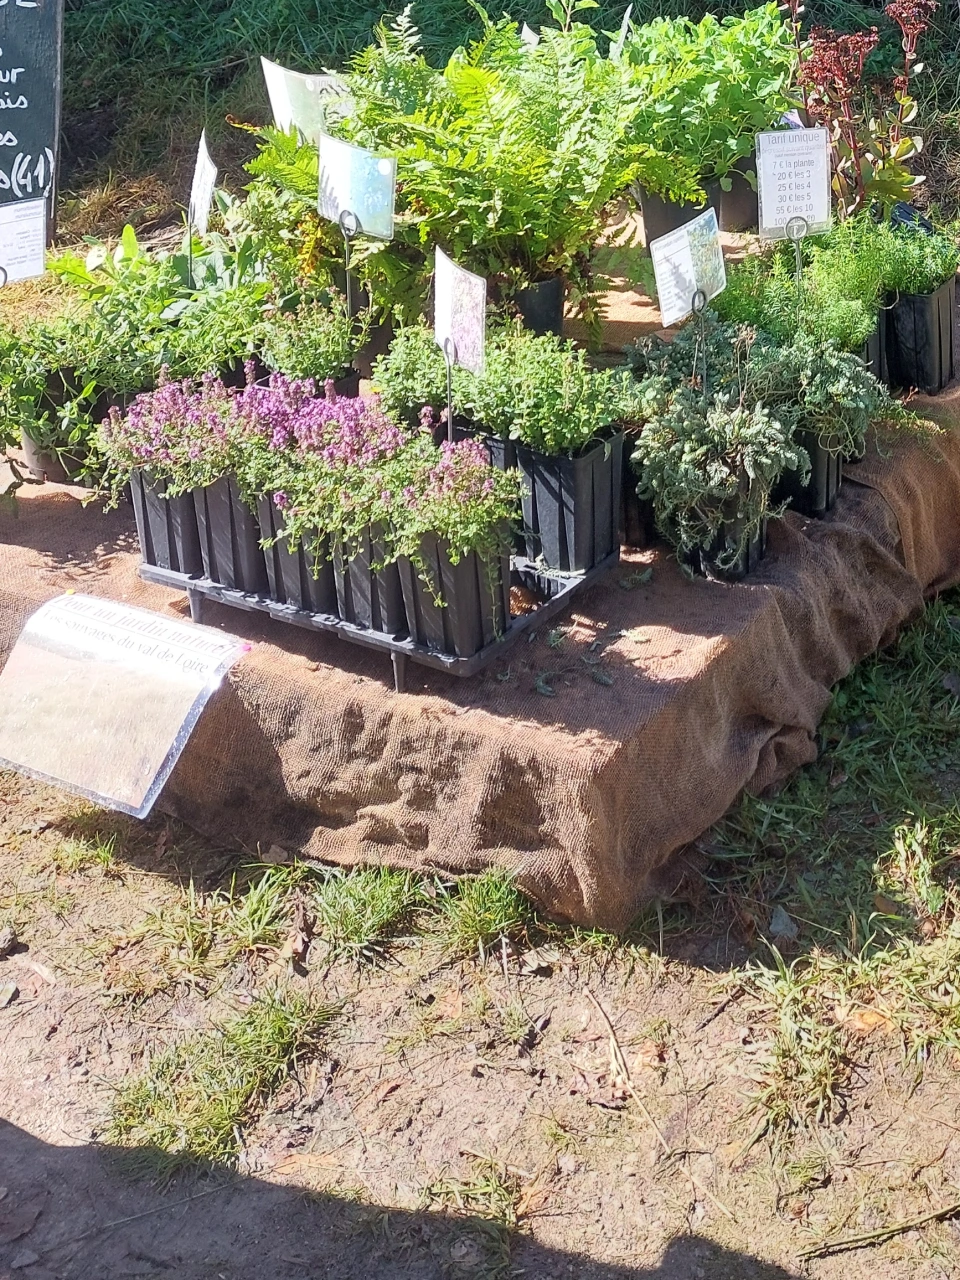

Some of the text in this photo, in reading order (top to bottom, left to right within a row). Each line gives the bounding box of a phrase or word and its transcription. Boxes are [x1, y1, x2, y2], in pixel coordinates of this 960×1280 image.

[766, 131, 820, 145] Tarif unique
[773, 158, 815, 170] 7 € la plante
[777, 169, 811, 181] 20 € les 3
[777, 181, 811, 192] 25 € les 4
[777, 192, 812, 203] 30 € les 5
[775, 203, 814, 215] 55 € les 10
[774, 216, 787, 226] 100
[110, 612, 168, 638] jardin
[64, 619, 115, 644] sauvages
[117, 635, 136, 650] du
[137, 642, 158, 656] val
[156, 648, 174, 664] de
[175, 652, 209, 674] Loire
